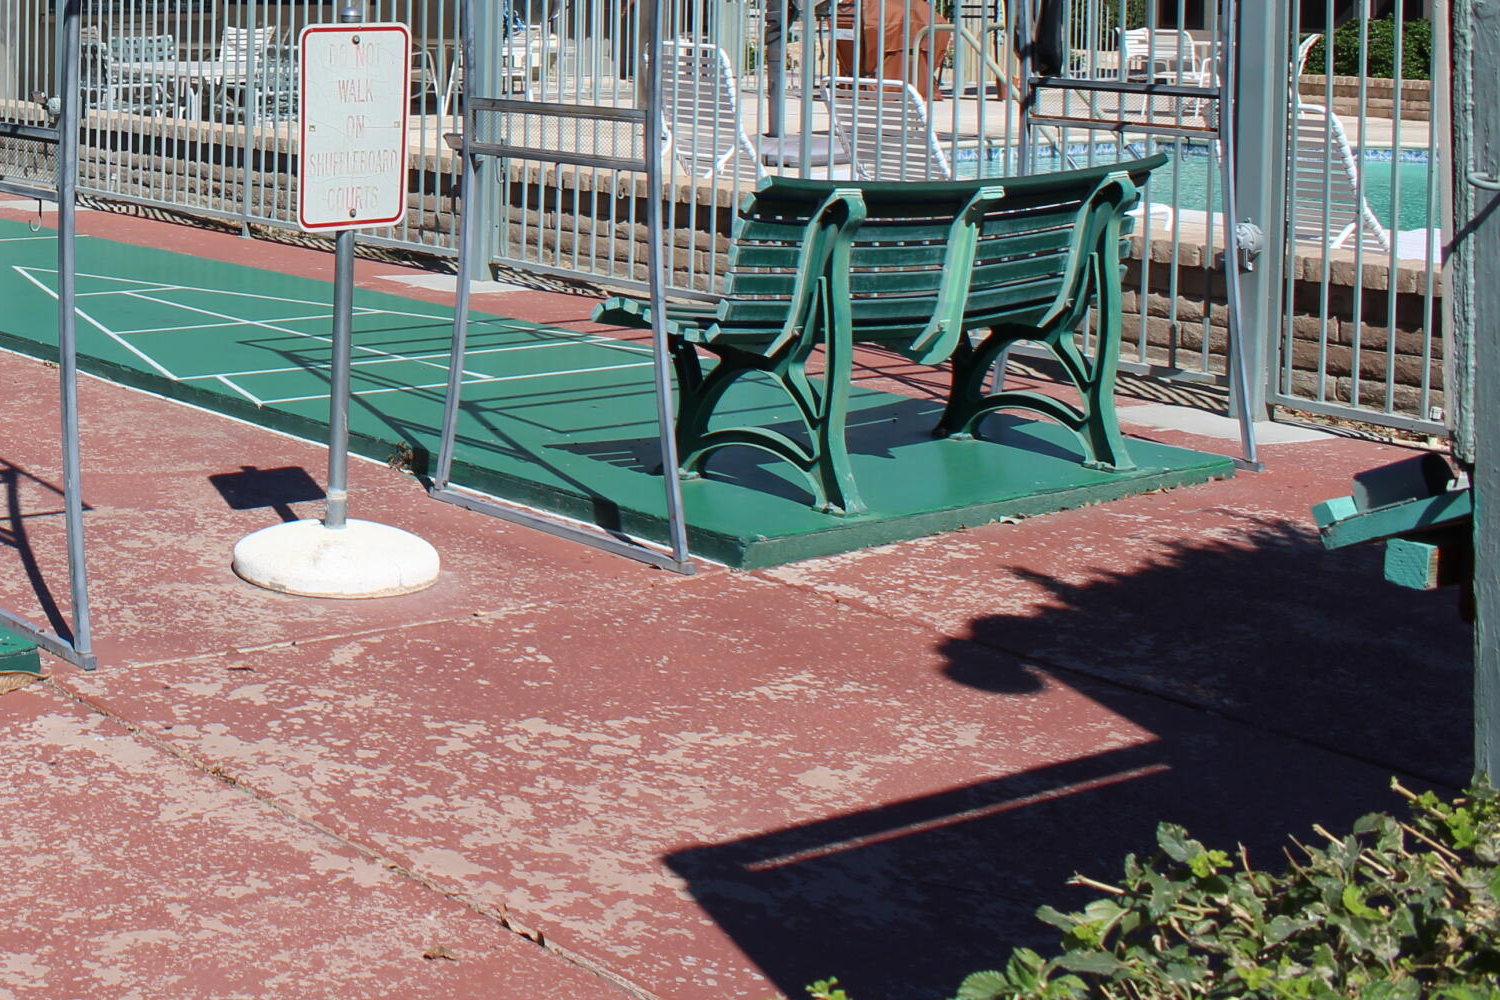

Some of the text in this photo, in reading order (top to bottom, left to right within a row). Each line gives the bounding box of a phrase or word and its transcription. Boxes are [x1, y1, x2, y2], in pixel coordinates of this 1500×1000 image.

[329, 43, 381, 67] DO NOT
[337, 79, 373, 104] WALK
[346, 114, 364, 139] ON
[308, 149, 398, 176] SHUFFLEBOARD
[327, 186, 379, 211] COURTS
